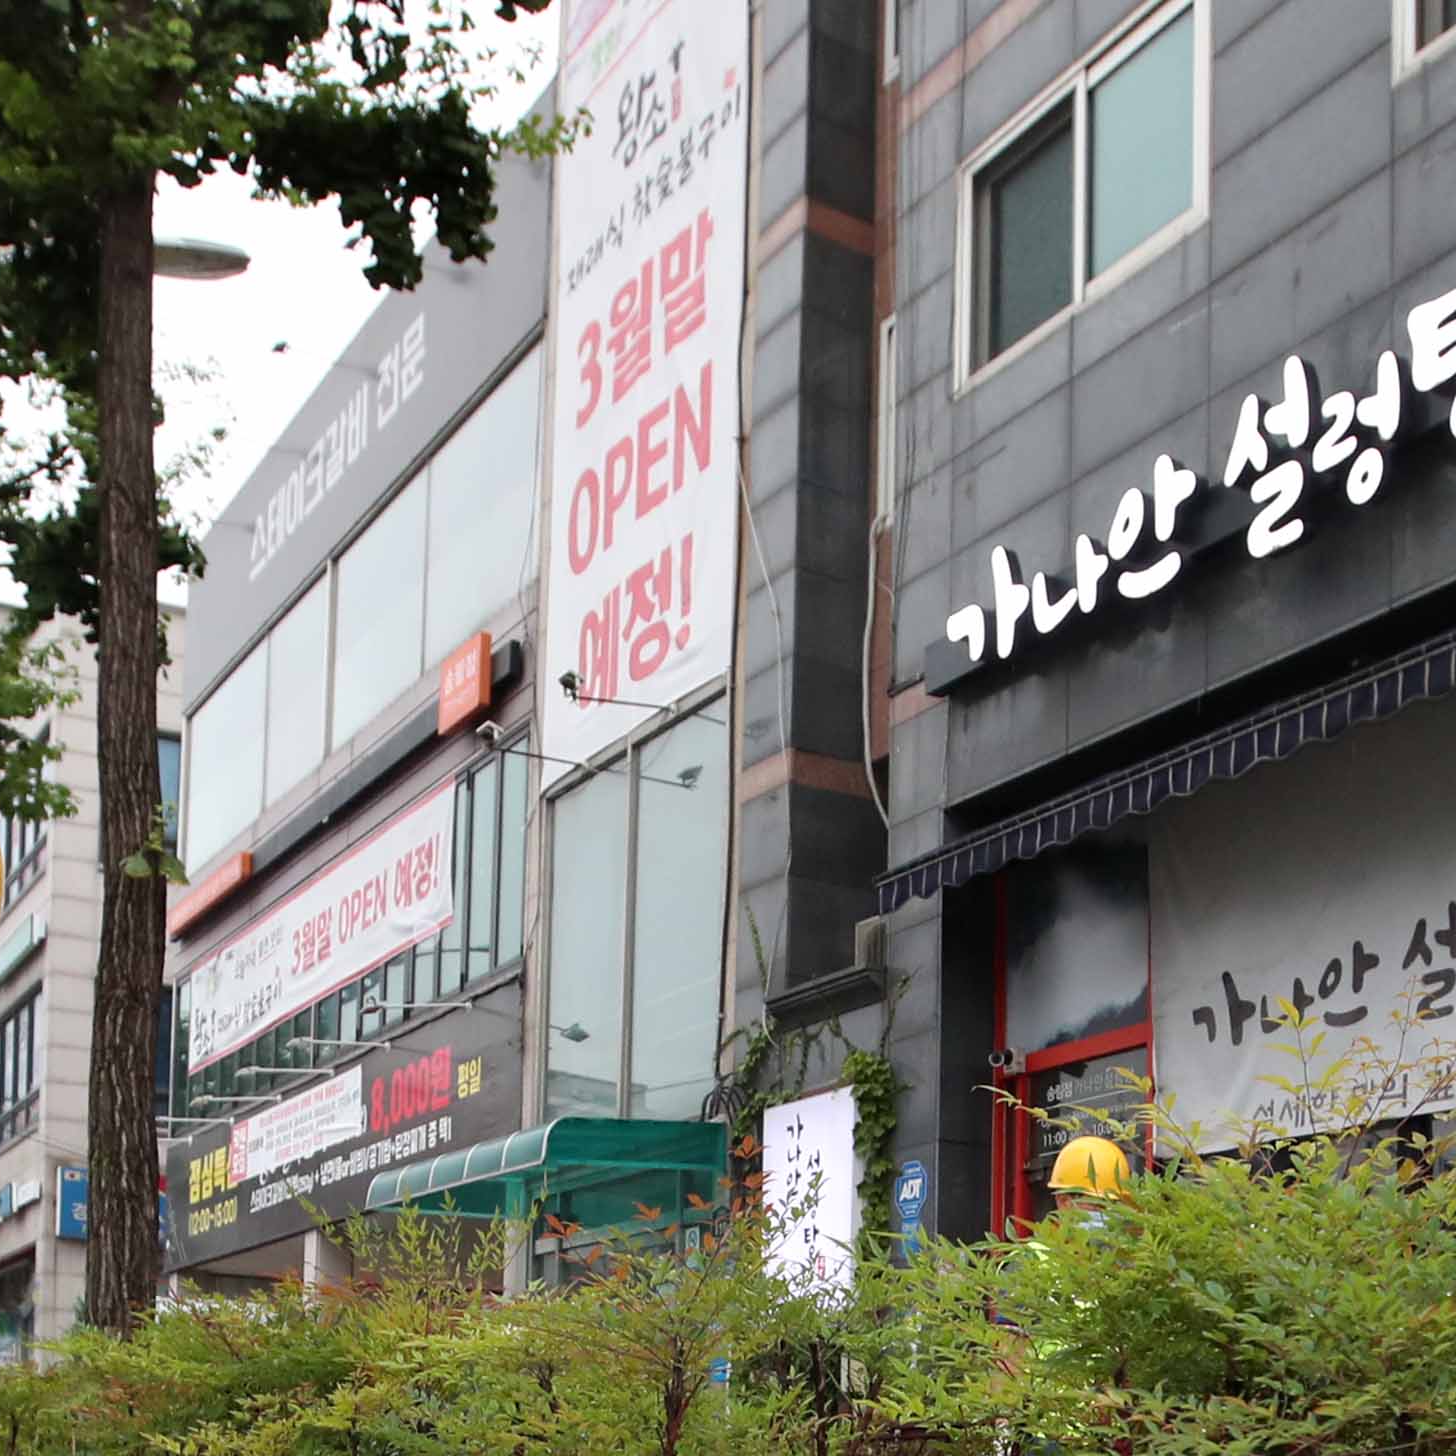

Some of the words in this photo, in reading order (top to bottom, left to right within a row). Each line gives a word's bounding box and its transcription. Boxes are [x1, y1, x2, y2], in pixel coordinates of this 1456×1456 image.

[575, 206, 714, 430] 3월말
[249, 380, 369, 583] 스테이크갈비
[376, 310, 425, 431] 전문
[568, 358, 712, 576] OPEN
[578, 531, 693, 710] 예정!
[946, 452, 1197, 662] 가나안
[291, 906, 333, 976] 3월말
[338, 870, 388, 945] OPEN
[393, 831, 441, 908] 예정!
[1192, 939, 1380, 1046] 가나안
[370, 1047, 452, 1137] 8,000원
[457, 1056, 482, 1100] 평일
[786, 1113, 804, 1201] 가나안
[189, 1144, 238, 1205] 점심특
[899, 1178, 923, 1201] ADT
